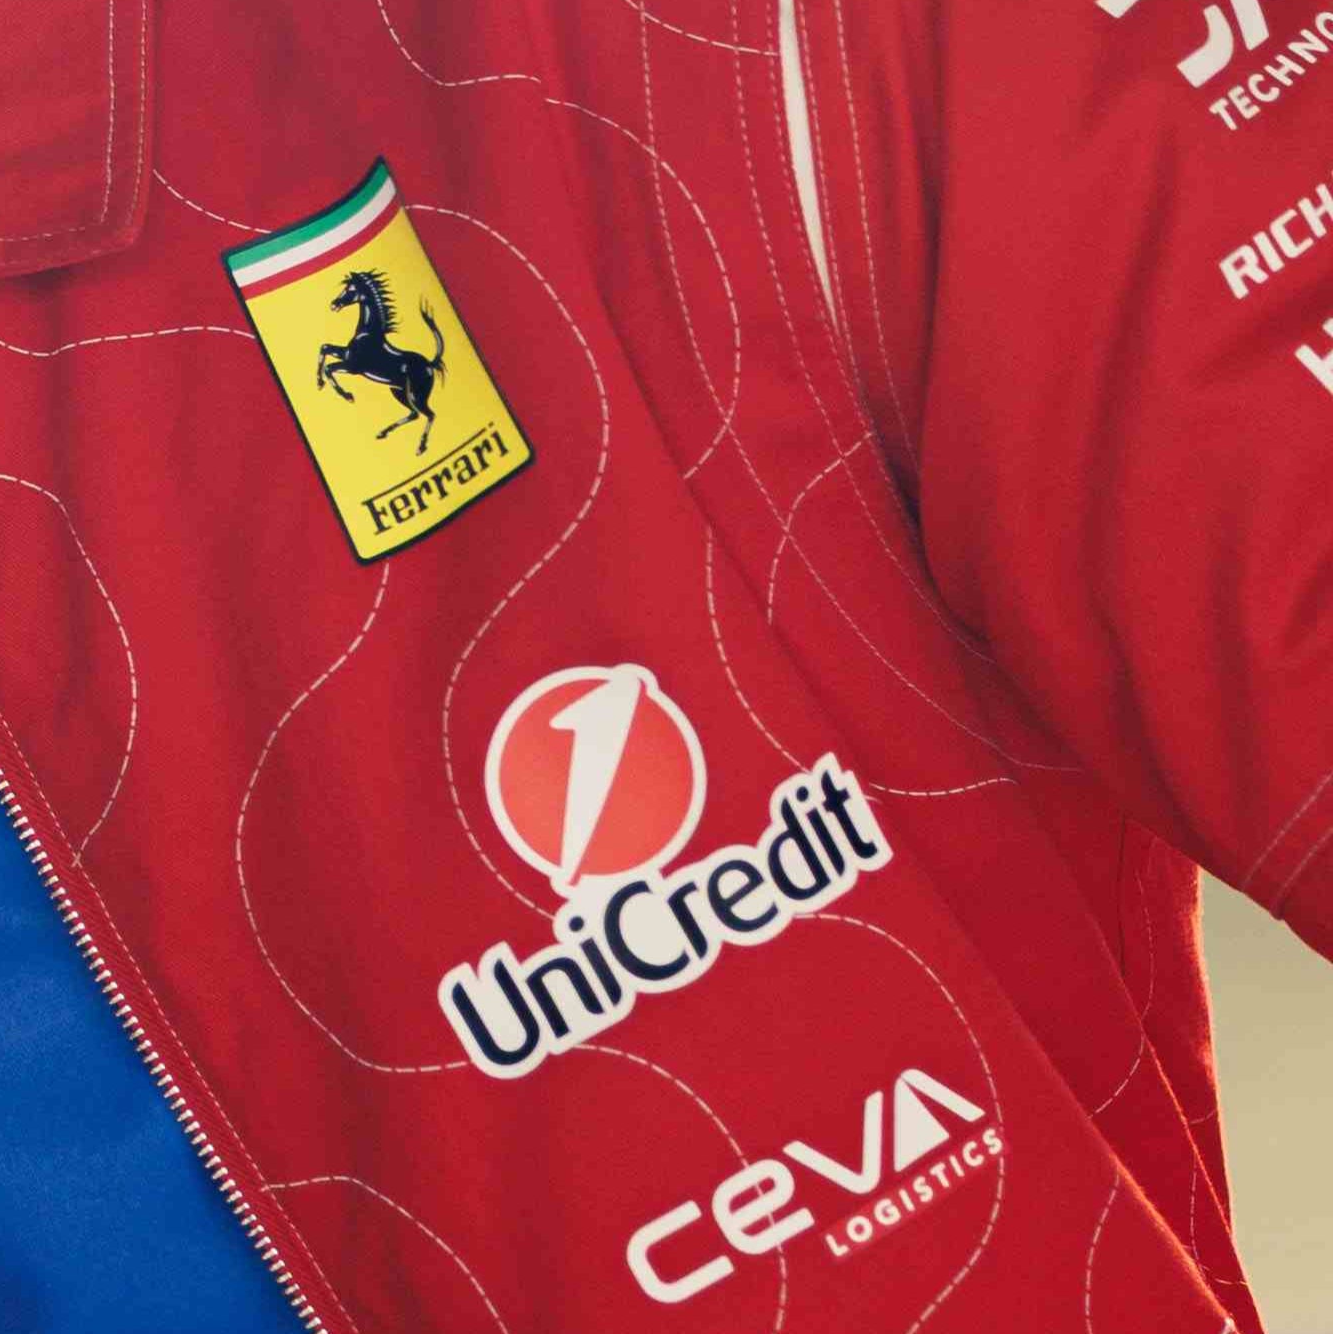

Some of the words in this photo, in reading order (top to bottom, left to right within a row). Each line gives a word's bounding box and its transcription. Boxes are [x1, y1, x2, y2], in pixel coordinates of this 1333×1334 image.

[360, 421, 510, 536] Ferrari
[451, 769, 879, 1066] UniCredit
[824, 1127, 1004, 1257] LOGISTICS
